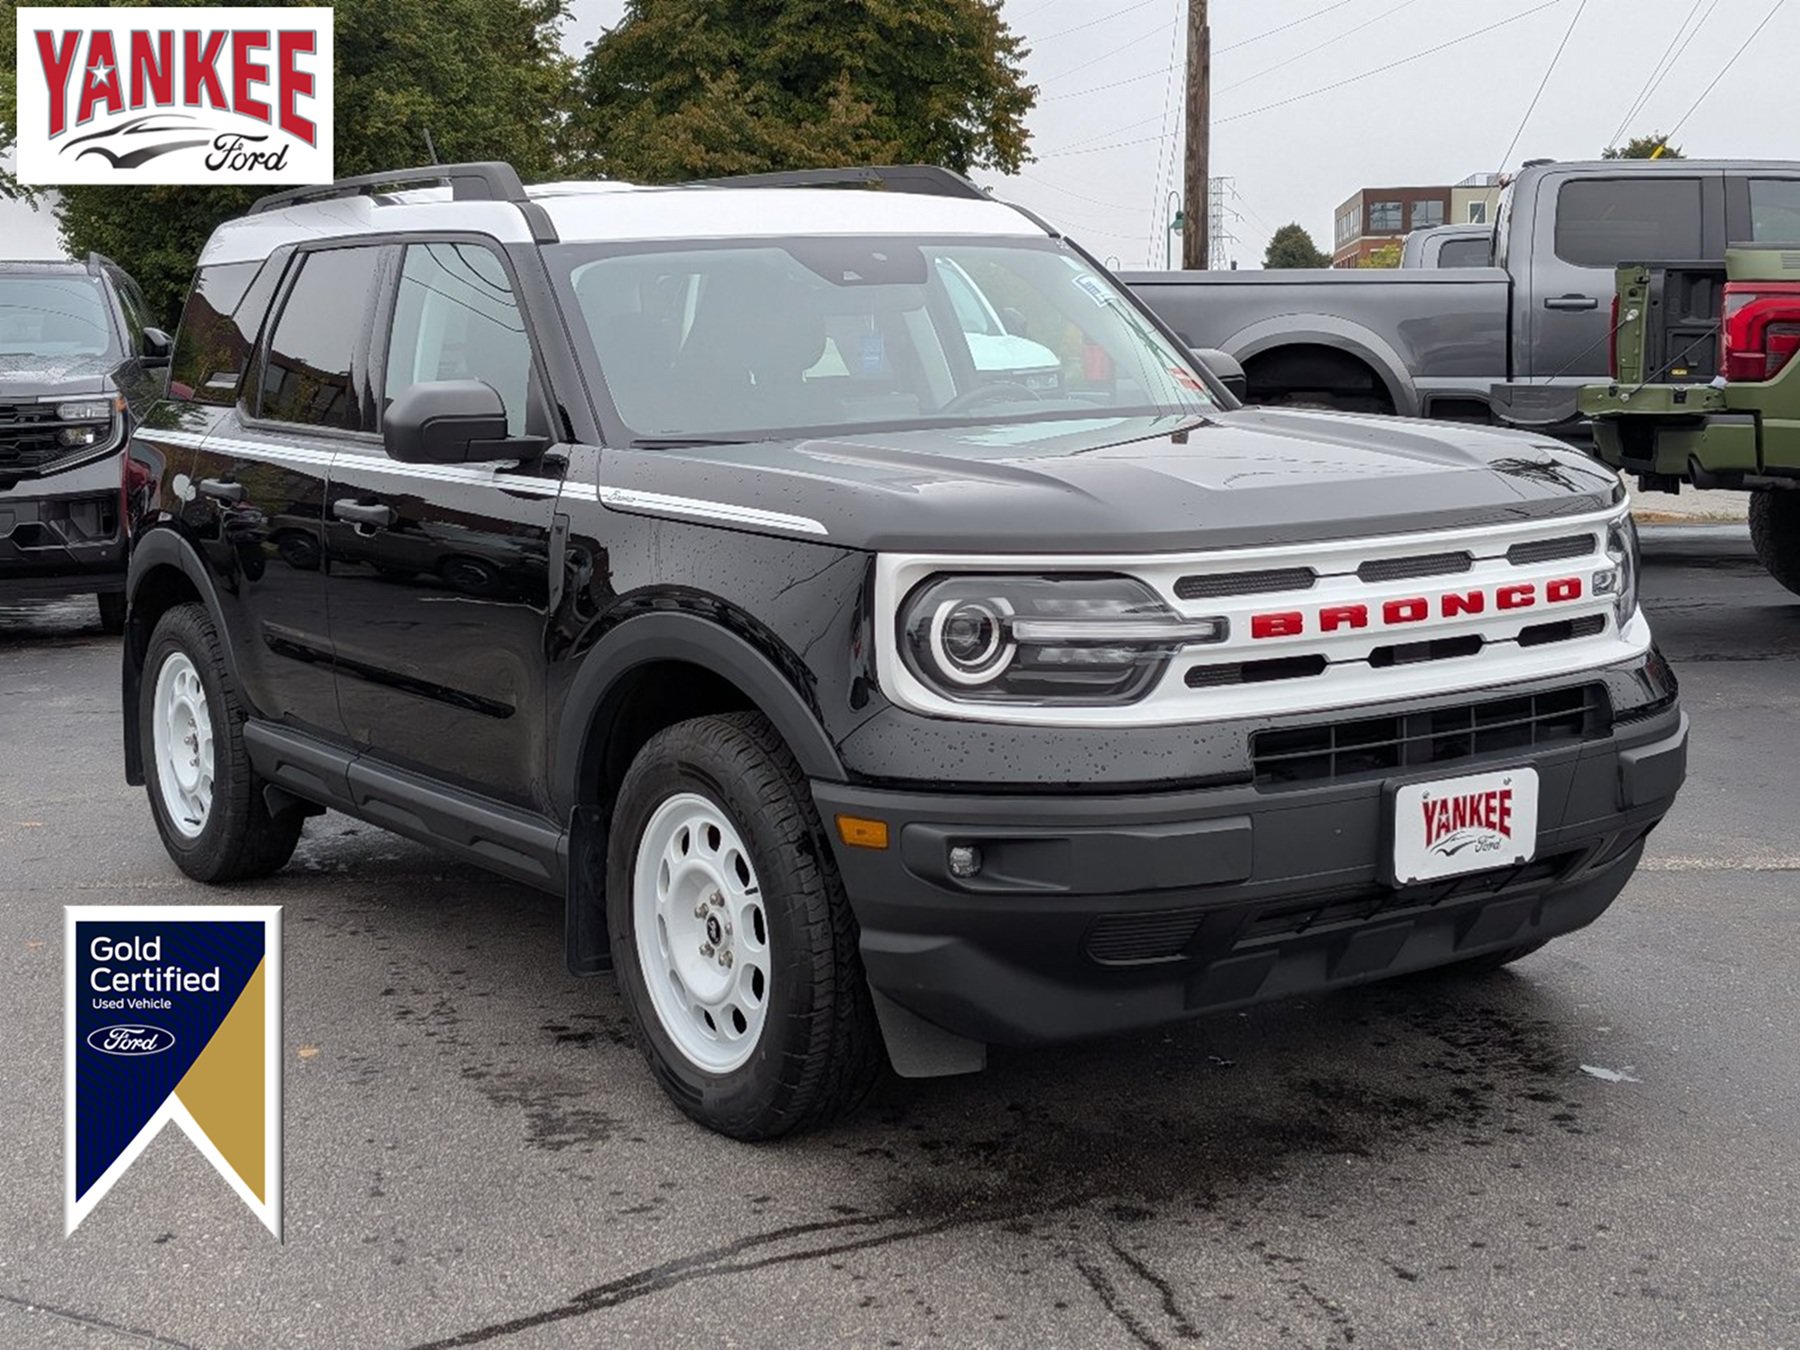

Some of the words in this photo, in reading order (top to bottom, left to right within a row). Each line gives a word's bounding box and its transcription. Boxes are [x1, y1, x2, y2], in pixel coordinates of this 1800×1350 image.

[1251, 577, 1582, 639] BRONCO
[1422, 788, 1513, 849] YANKEE
[1474, 835, 1502, 852] Ford
